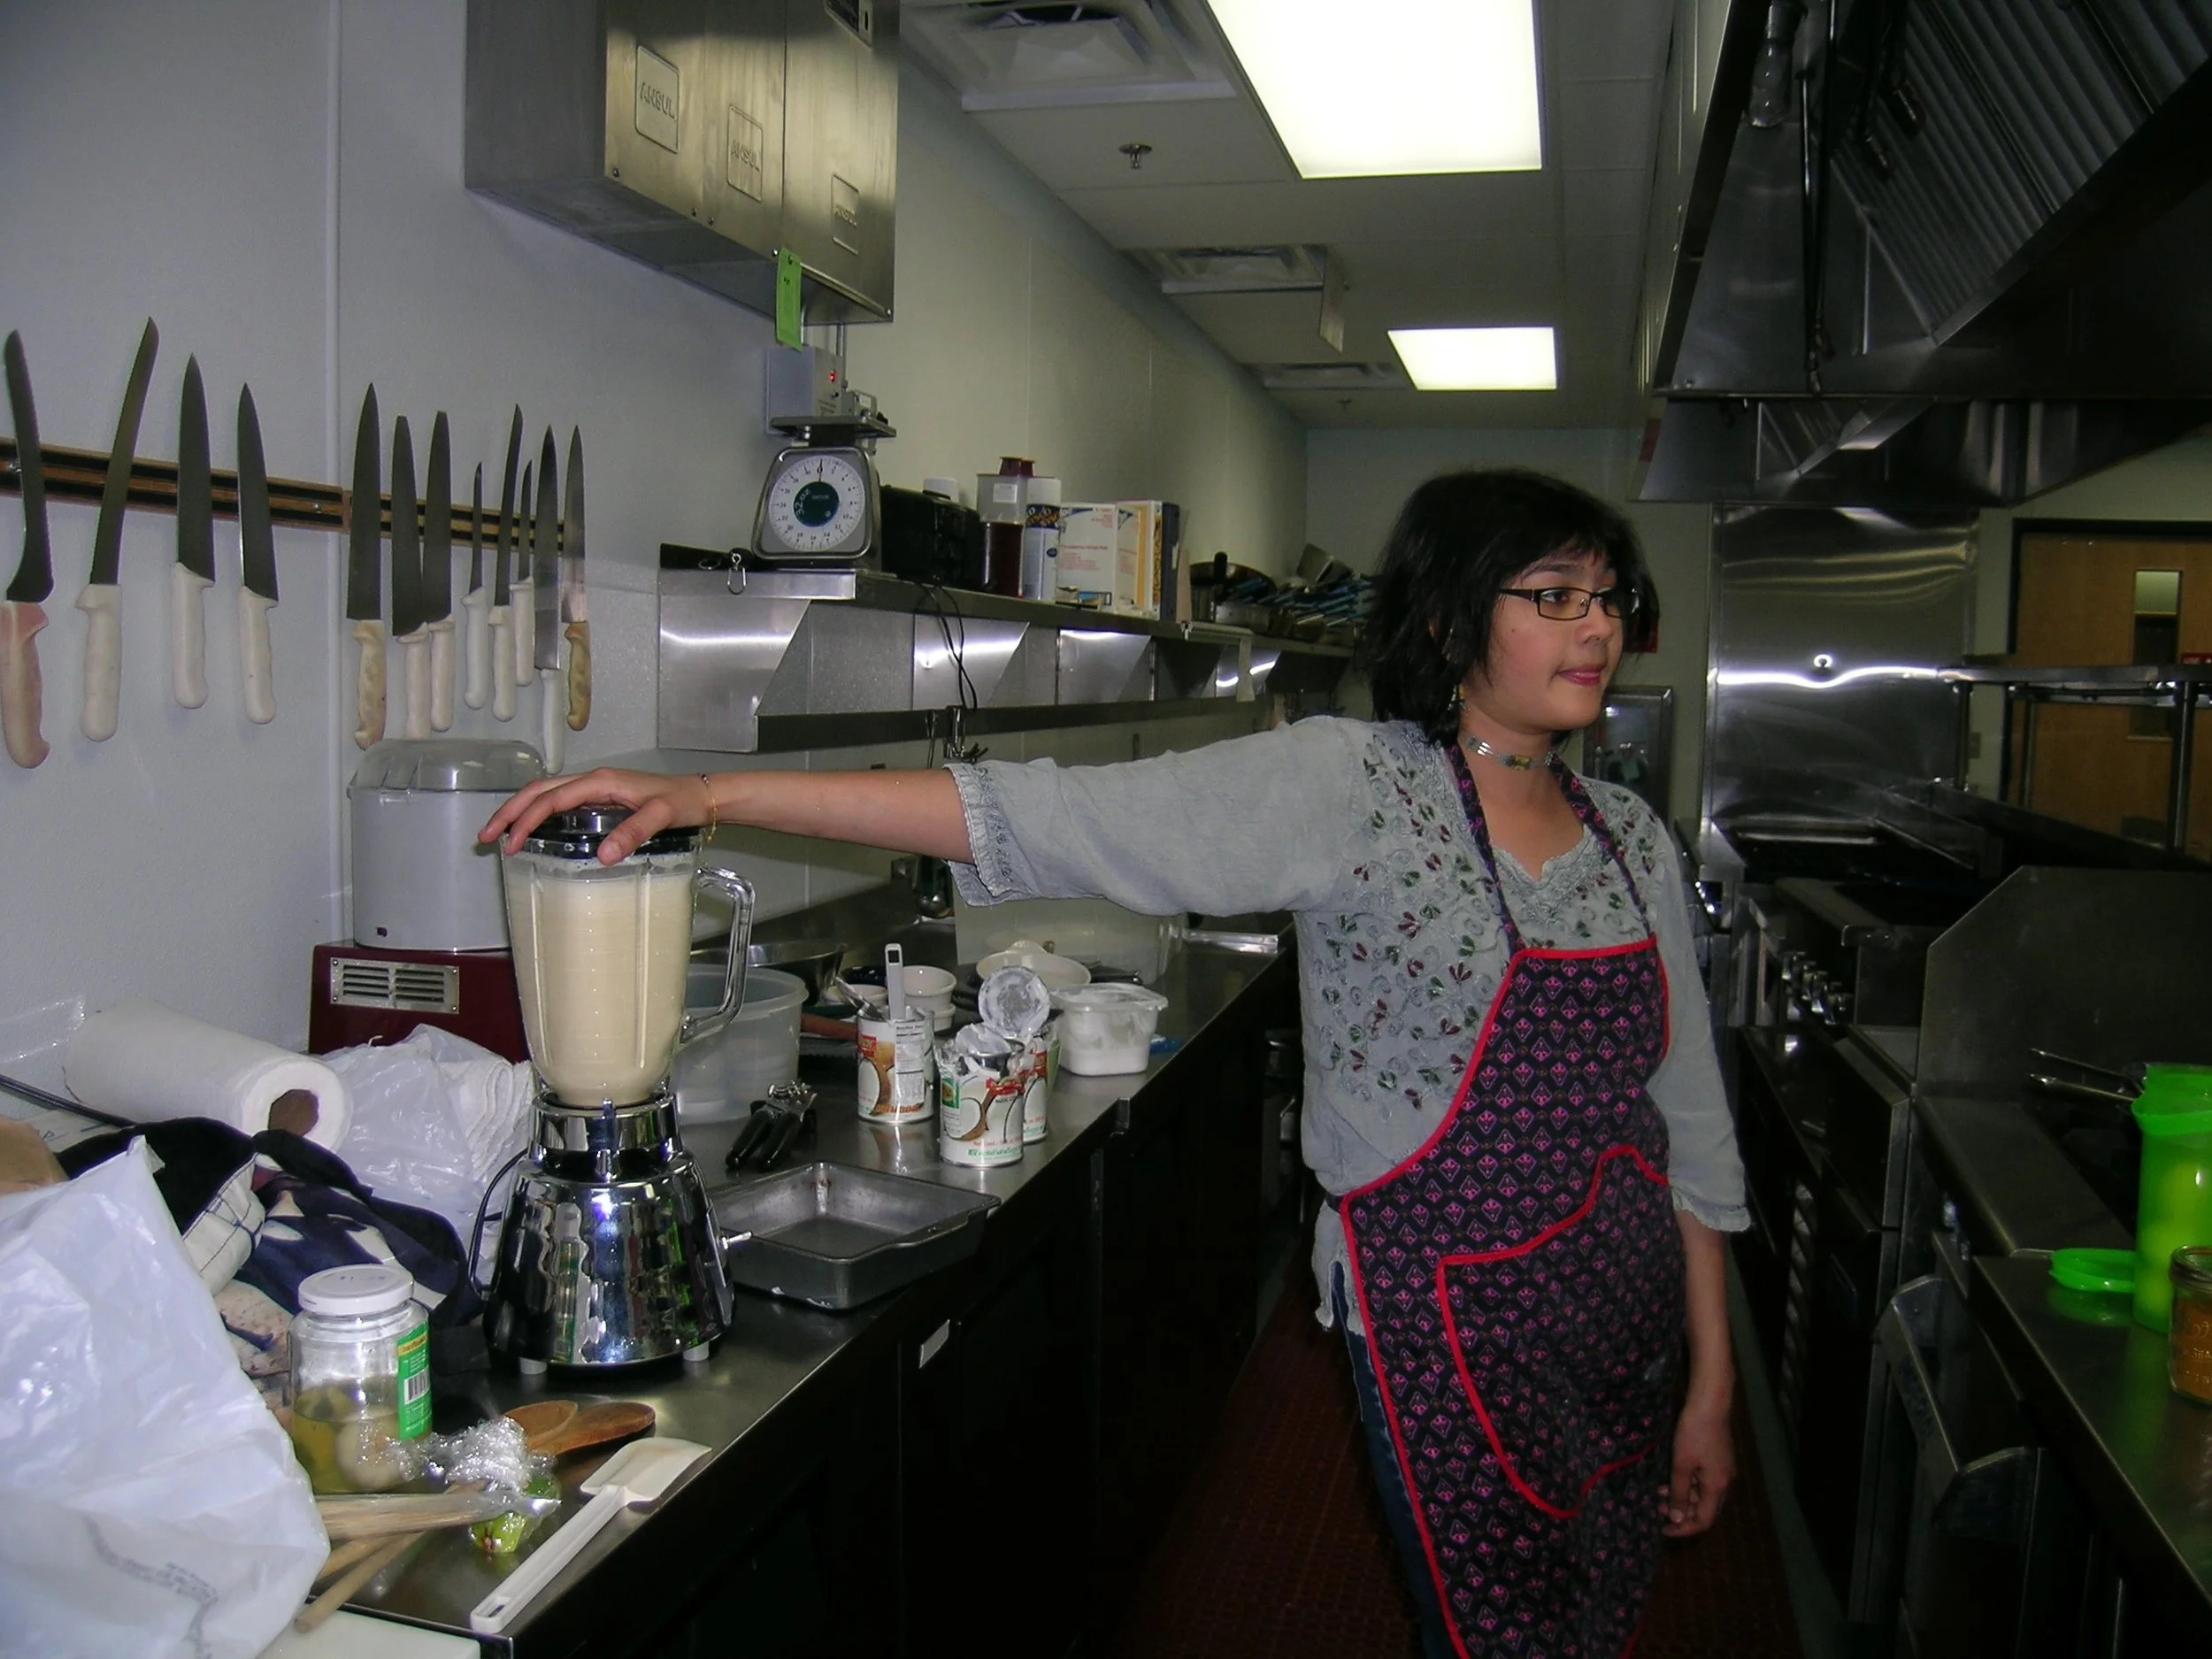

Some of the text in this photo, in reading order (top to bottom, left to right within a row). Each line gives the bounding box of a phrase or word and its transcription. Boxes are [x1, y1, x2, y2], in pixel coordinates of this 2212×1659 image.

[640, 81, 675, 121] ANSUL
[730, 140, 760, 172] ANSUL
[795, 502, 805, 517] 32
